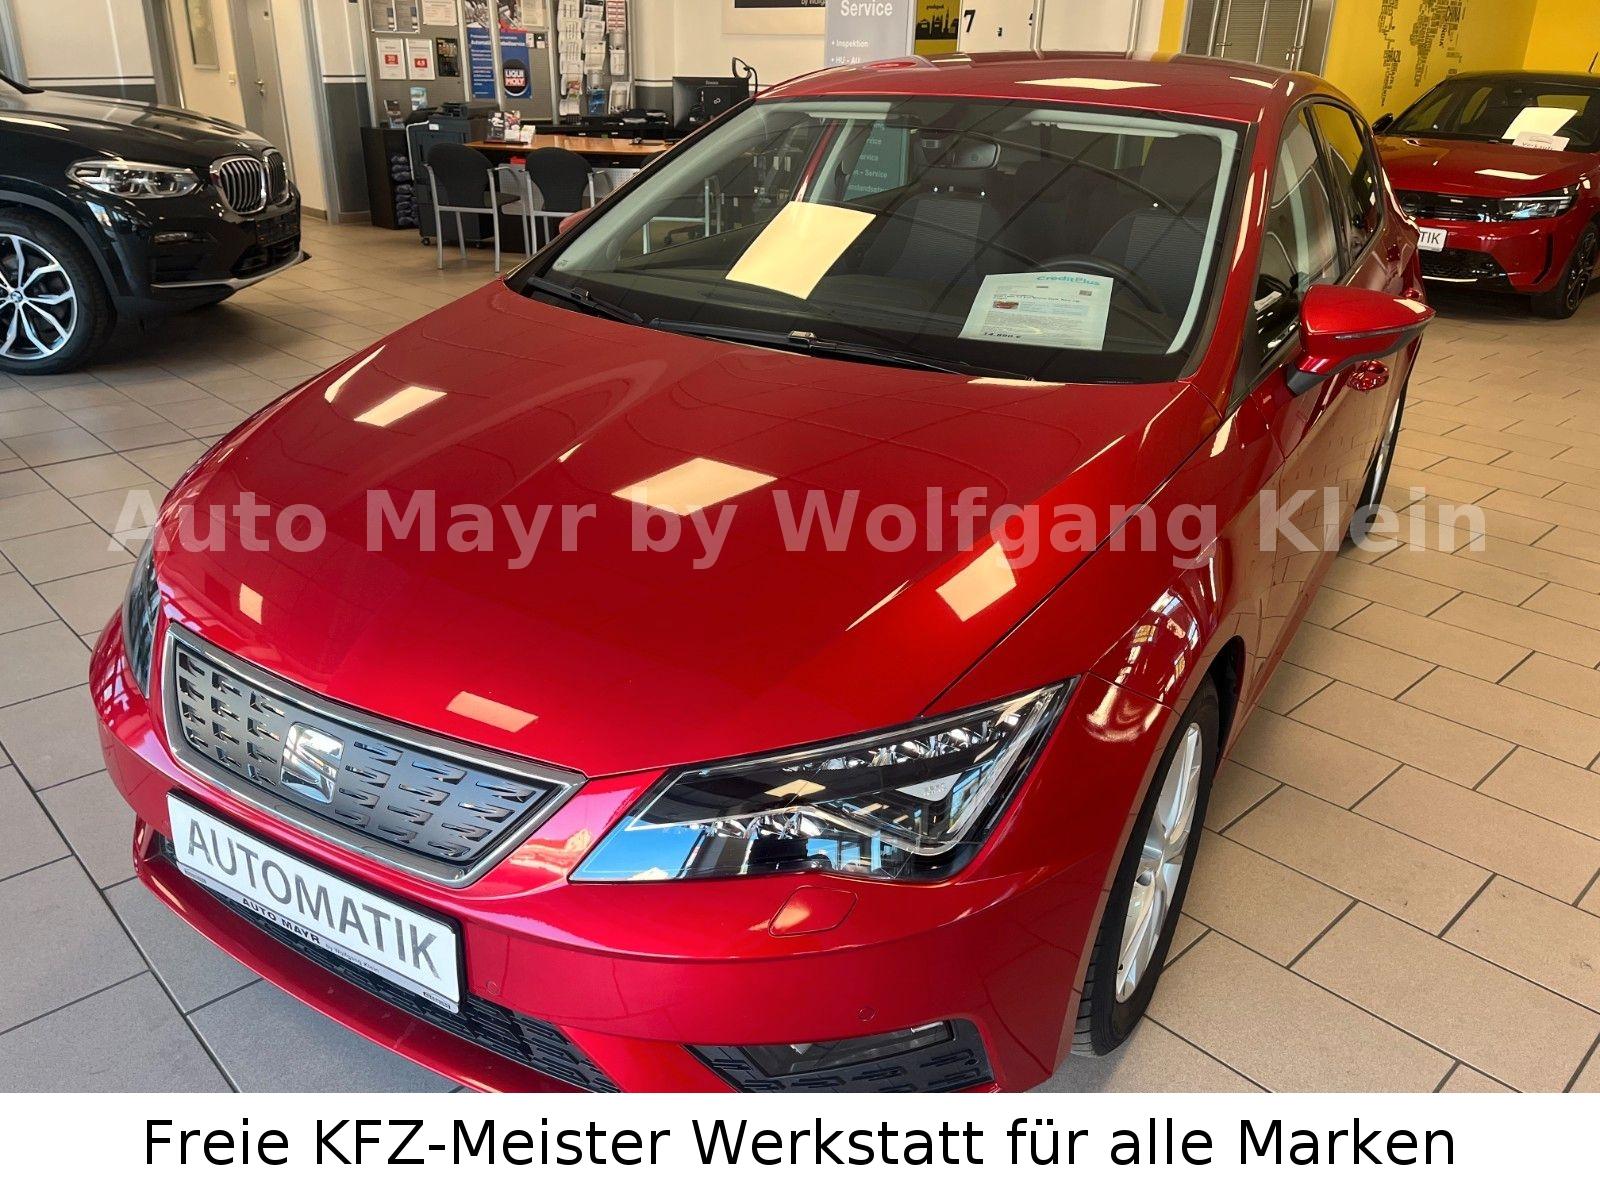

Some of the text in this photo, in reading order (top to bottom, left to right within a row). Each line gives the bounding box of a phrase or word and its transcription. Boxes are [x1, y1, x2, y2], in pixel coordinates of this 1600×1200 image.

[840, 0, 893, 17] Service
[963, 9, 976, 33] 7
[836, 40, 869, 48] Inspektion
[505, 69, 524, 77] LIQUI
[505, 78, 525, 86] MOLY
[1037, 275, 1101, 286] CreditPlus
[187, 817, 442, 981] AUTOMATIK
[243, 898, 277, 921] AUTO
[281, 918, 320, 944] MAYR
